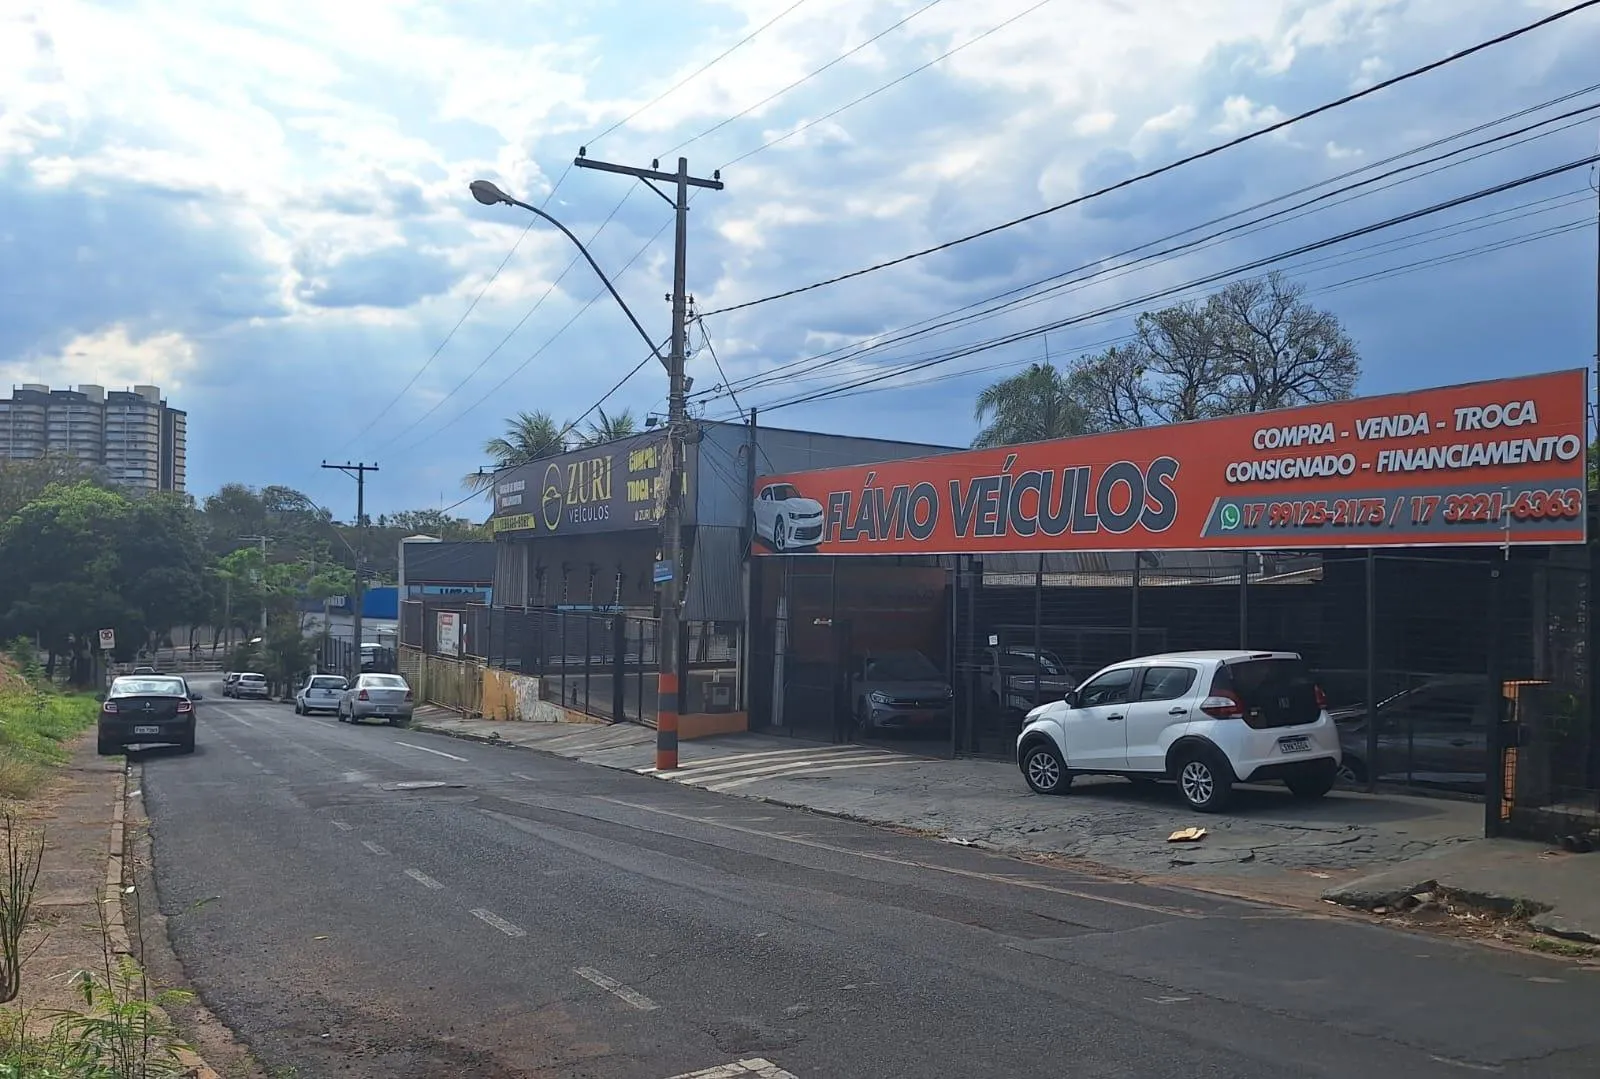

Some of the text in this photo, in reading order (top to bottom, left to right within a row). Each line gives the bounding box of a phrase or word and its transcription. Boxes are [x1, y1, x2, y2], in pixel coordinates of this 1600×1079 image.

[1253, 422, 1335, 450] COMPRA
[1355, 412, 1430, 441] VENDA
[1454, 400, 1538, 432] TROCA
[566, 455, 613, 505] ZURI
[1225, 453, 1356, 483] CONSIGNADO
[1377, 434, 1581, 474] FINANCIAMENTO
[568, 505, 609, 523] VEÍCULOS
[824, 454, 1181, 543] FLÁVIO VEÍCULOS
[1243, 503, 1266, 526] 17
[1268, 498, 1386, 526] 99125-2175
[1411, 496, 1442, 525] 17
[1443, 488, 1582, 523] 3221-6363
